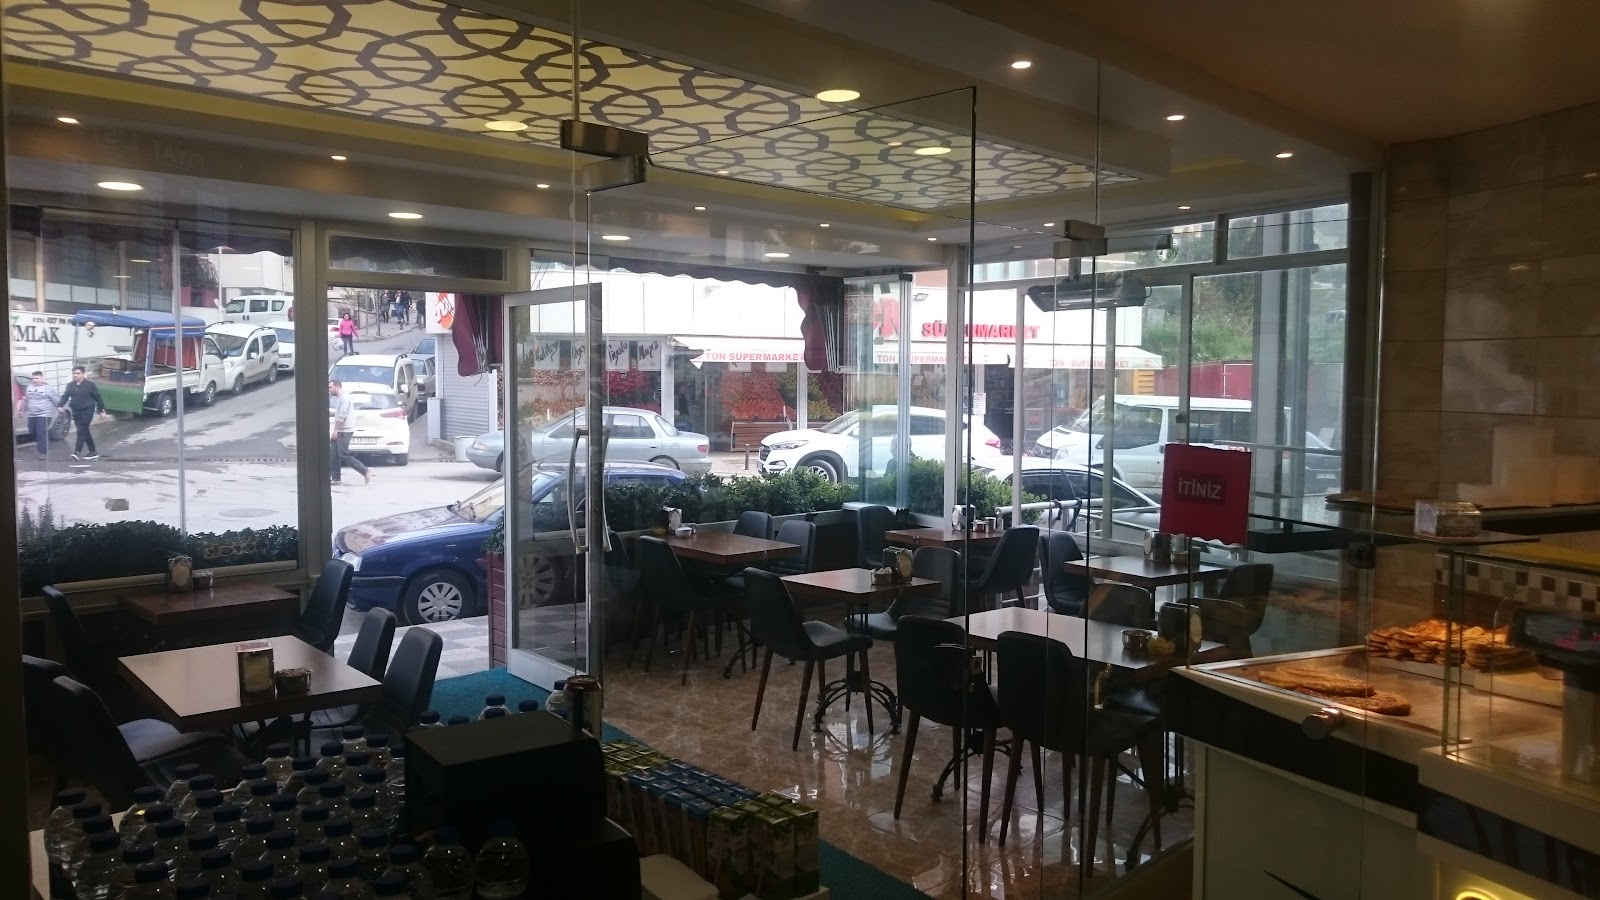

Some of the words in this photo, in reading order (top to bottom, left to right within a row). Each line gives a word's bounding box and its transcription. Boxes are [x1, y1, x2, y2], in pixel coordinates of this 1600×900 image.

[706, 351, 726, 361] TON
[876, 354, 896, 363] TON
[1178, 476, 1222, 500] İTİNİZ
